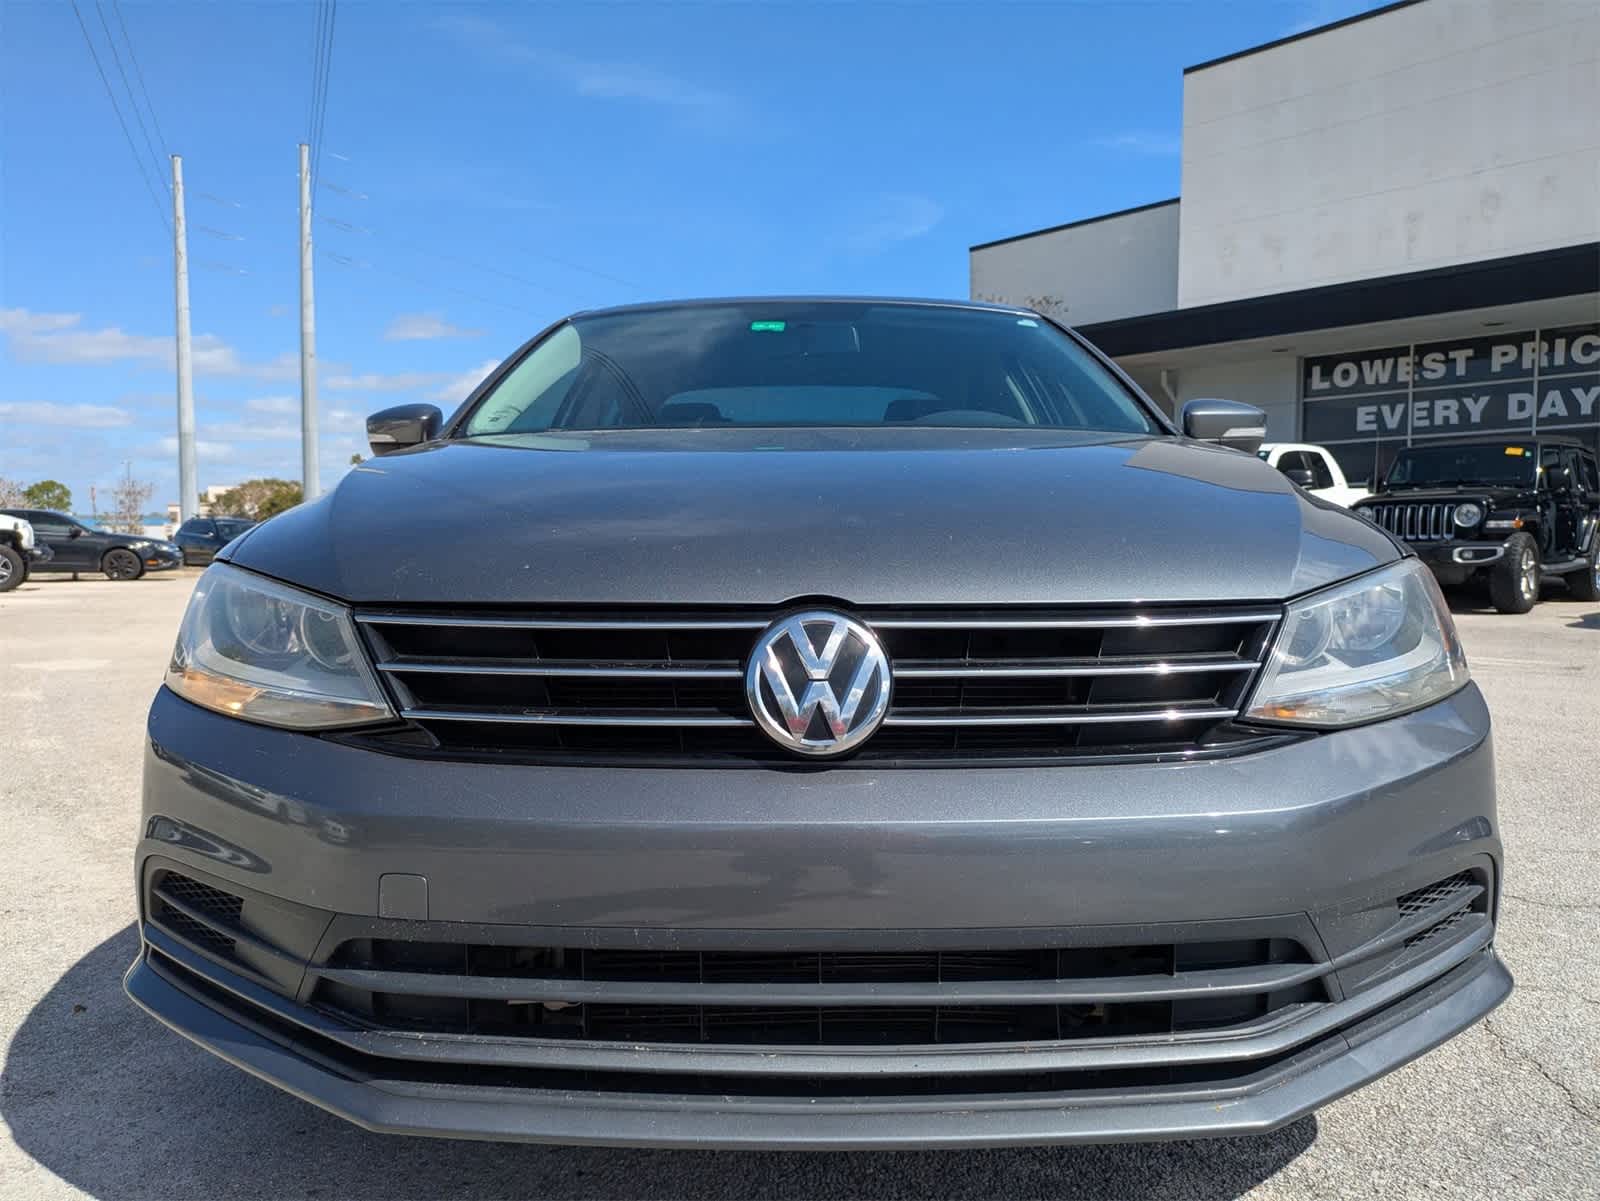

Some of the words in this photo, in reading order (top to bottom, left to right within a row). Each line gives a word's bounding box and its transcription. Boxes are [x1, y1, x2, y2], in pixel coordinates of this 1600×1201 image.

[1311, 349, 1474, 390] LOWEST
[1356, 396, 1490, 432] EVERY
[1507, 386, 1600, 420] DAY
[747, 611, 890, 754] VW
